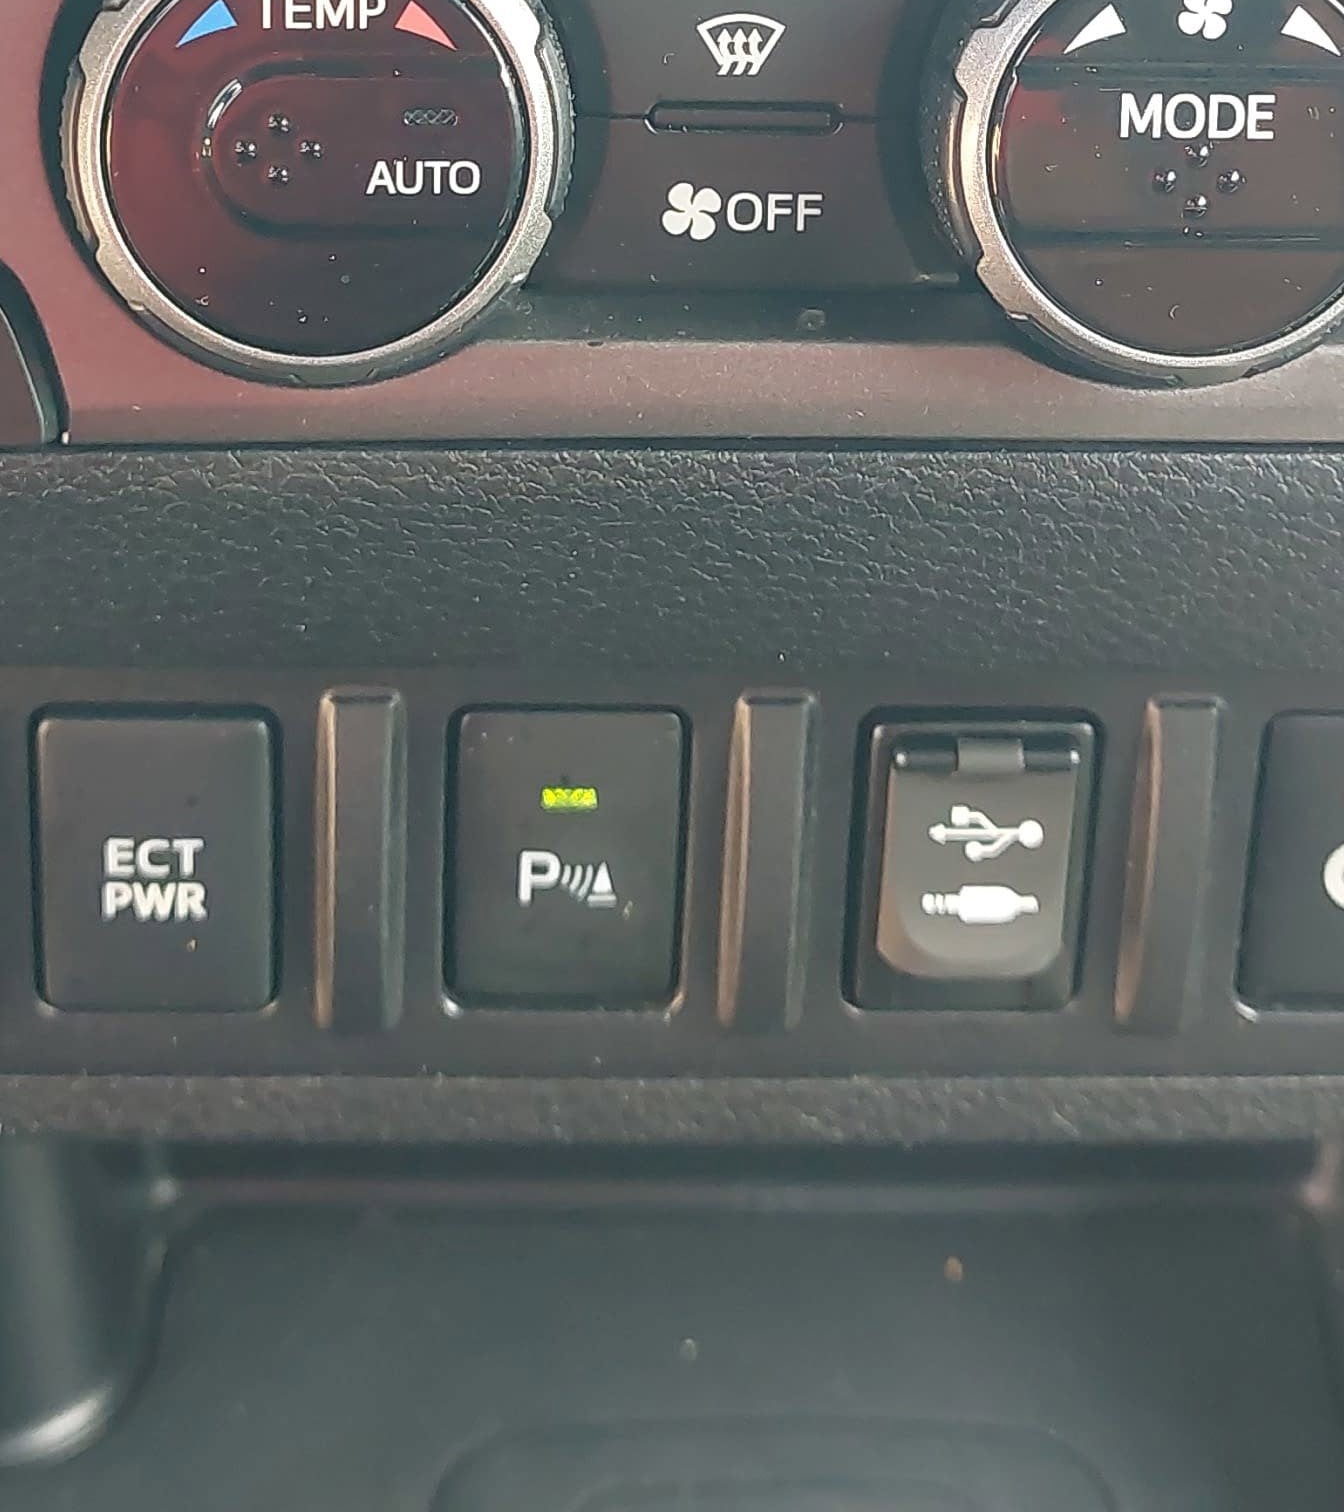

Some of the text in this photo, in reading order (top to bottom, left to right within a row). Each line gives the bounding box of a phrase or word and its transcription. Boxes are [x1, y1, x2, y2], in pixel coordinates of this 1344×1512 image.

[1119, 92, 1276, 142] MODE
[365, 159, 482, 197] AUTO
[726, 192, 824, 234] OFF
[103, 837, 205, 878] ECT
[518, 849, 561, 908] P
[101, 881, 208, 923] PWR
